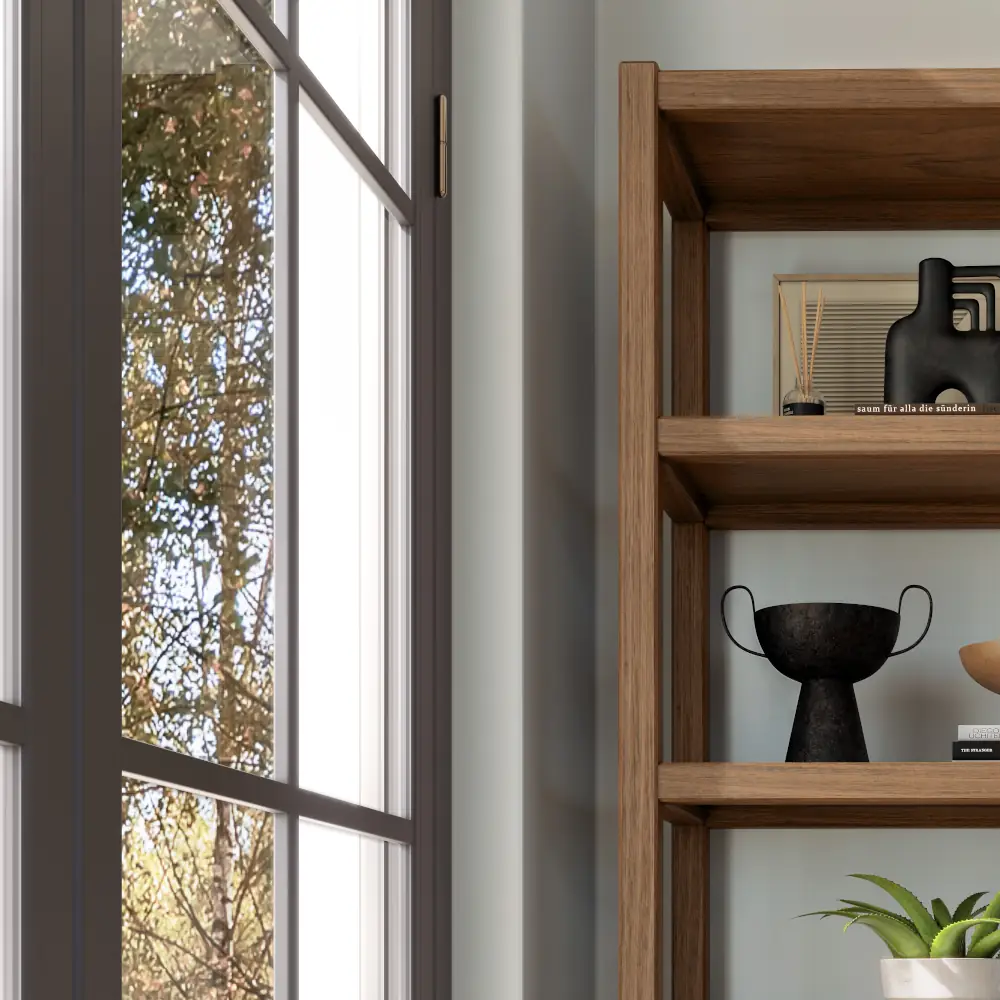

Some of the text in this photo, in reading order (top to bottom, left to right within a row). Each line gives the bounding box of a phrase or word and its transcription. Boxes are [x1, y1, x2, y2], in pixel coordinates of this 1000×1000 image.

[899, 404, 916, 412] alla
[919, 404, 933, 412] die
[936, 404, 976, 412] sünderin
